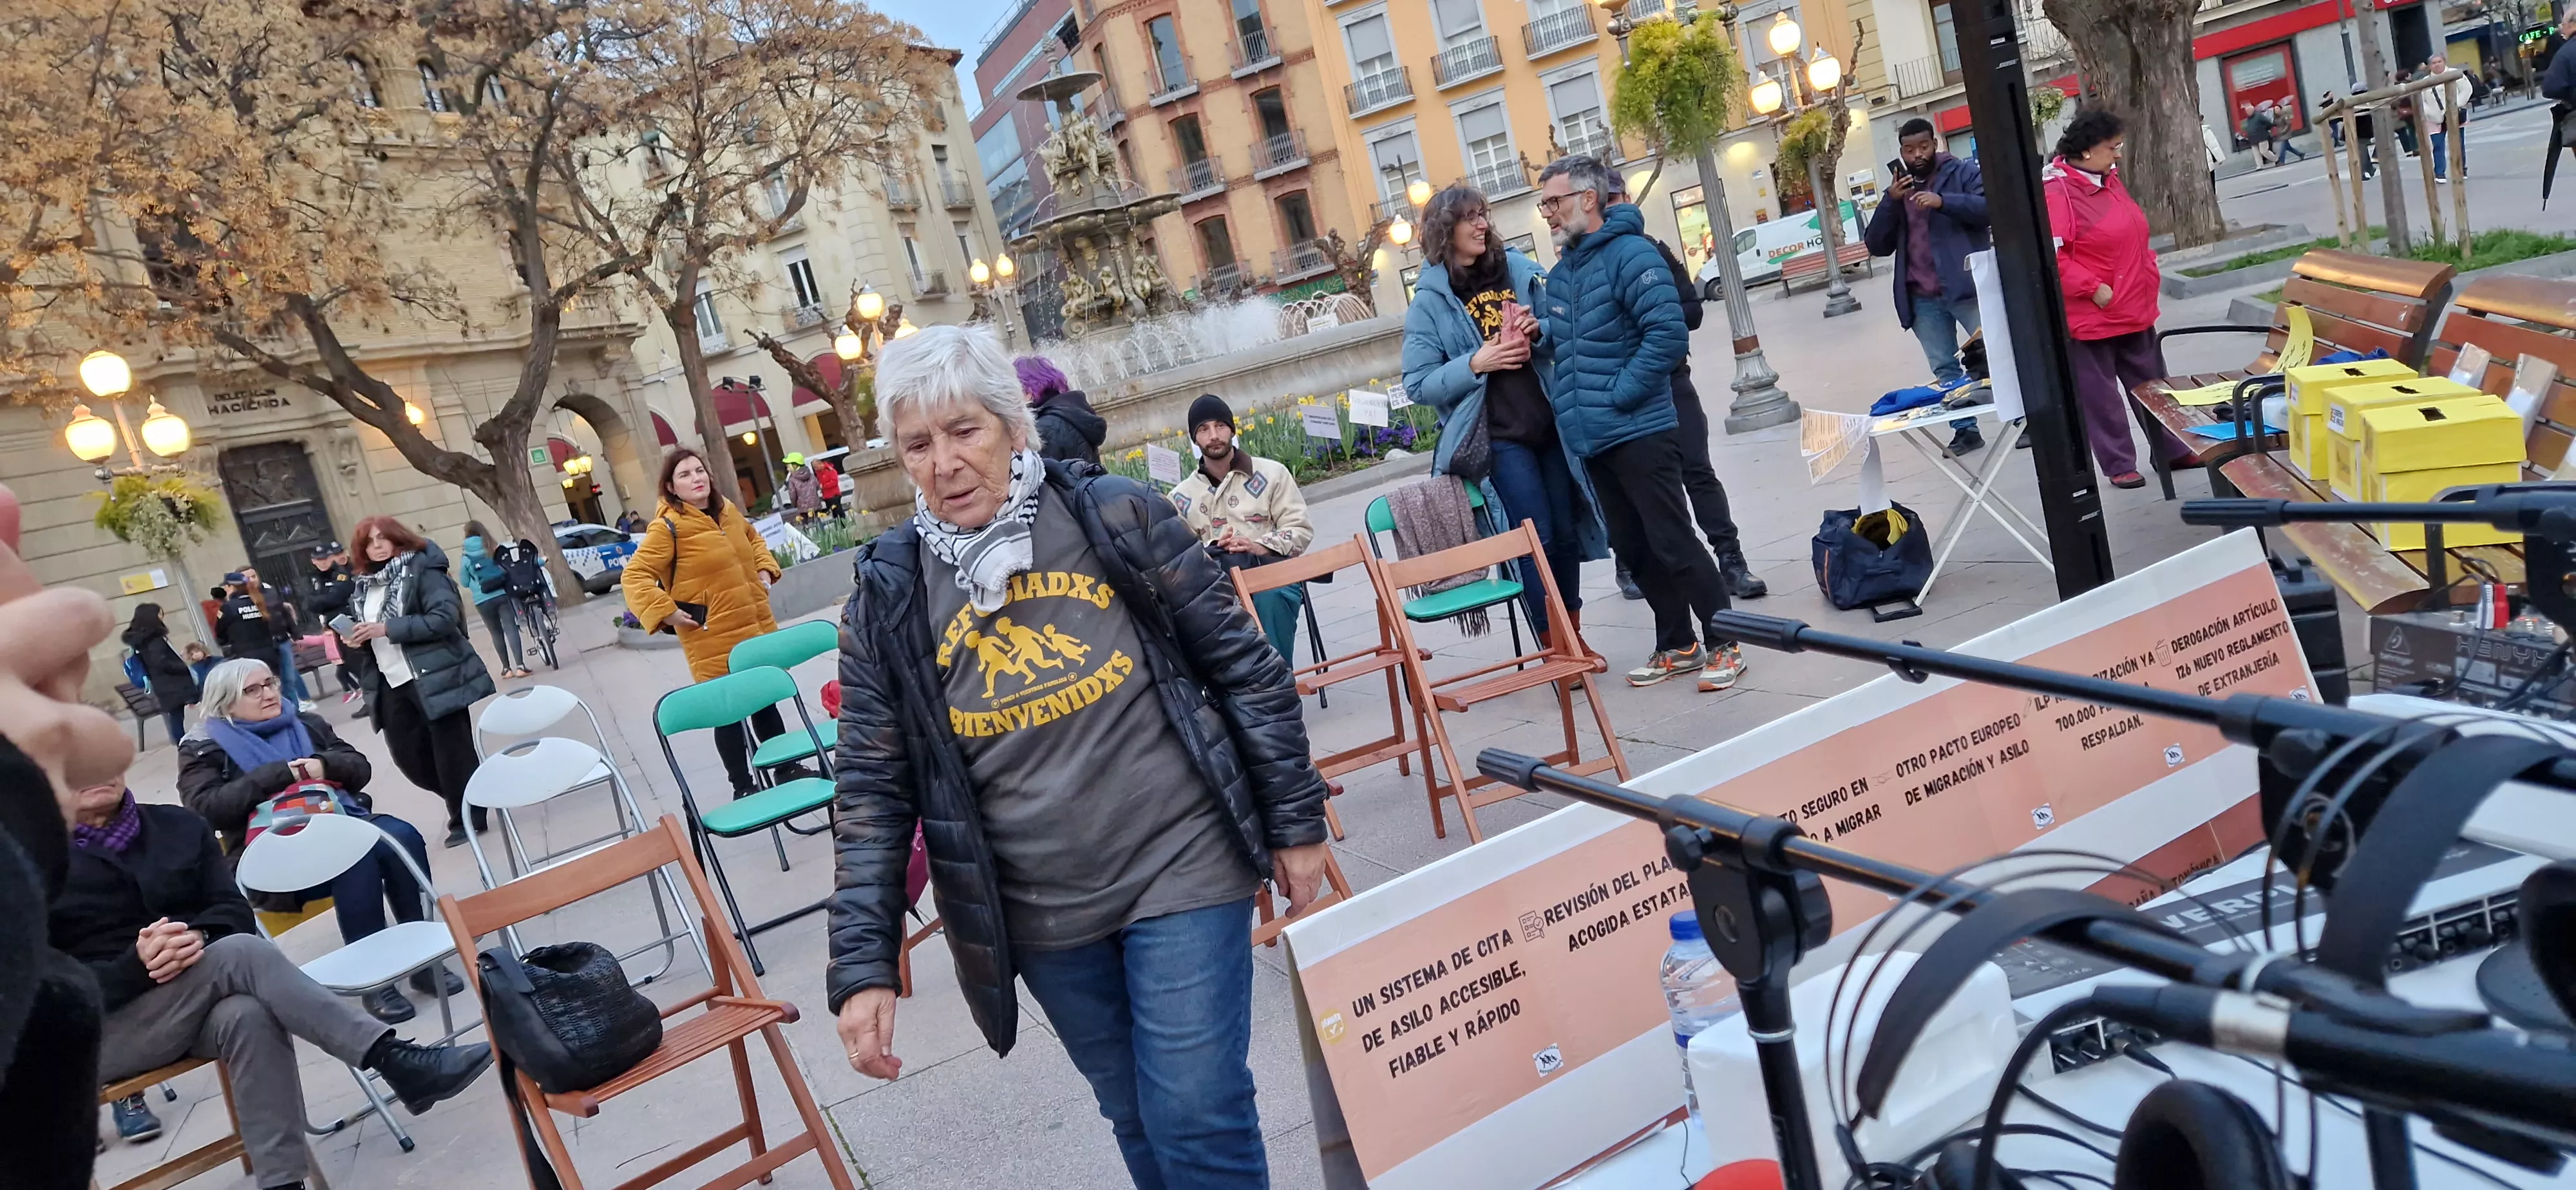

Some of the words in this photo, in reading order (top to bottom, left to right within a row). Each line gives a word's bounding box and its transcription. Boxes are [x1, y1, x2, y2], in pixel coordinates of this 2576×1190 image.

[1768, 242, 1804, 258] DECOR
[936, 572, 1115, 667] REFIADXS
[2171, 616, 2230, 654] DEROGACIÓN
[2233, 598, 2278, 628] ARTÍCULO
[2175, 663, 2192, 680] 126
[2193, 648, 2224, 672] NUEVO
[2227, 621, 2289, 657] REGLAMENTO
[2197, 681, 2212, 697] DE
[2214, 650, 2280, 691] EXTRANJERÍA
[949, 649, 1133, 737] BIENVENIDXS
[2034, 695, 2050, 712] ILP
[2140, 652, 2155, 667] YA
[1896, 753, 1927, 778] OTRO
[1929, 735, 1968, 764] PACTO
[1971, 713, 2020, 746] EUROPEO
[2055, 705, 2096, 732] 700.000
[2081, 713, 2144, 751] RESPALDAN.
[1801, 786, 1848, 819] SEGURO
[1850, 777, 1869, 797] EN
[1905, 787, 1922, 806] DE
[1923, 758, 1985, 798] MIGRACIÓN
[1987, 754, 1994, 770] Y
[2000, 739, 2029, 764] ASILO
[1824, 827, 1834, 843] A
[1835, 804, 1882, 836] MIGRAR
[1544, 883, 1609, 927] REVISIÓN
[1612, 871, 1640, 895] DEL
[1642, 856, 1672, 881] PLA
[1569, 910, 1630, 952] ACOGIDA
[1352, 993, 1376, 1017] UN
[1380, 959, 1449, 1005] SISTEMA
[1451, 947, 1473, 970] DE
[1477, 929, 1513, 958] CITA
[1361, 1028, 1385, 1053] DE
[1391, 1004, 1433, 1040] ASILO
[1440, 961, 1526, 1015] ACCESIBLE,
[1389, 1035, 1445, 1079] FIABLE
[1448, 1028, 1459, 1046] Y
[1464, 998, 1520, 1039] RÁPIDO
